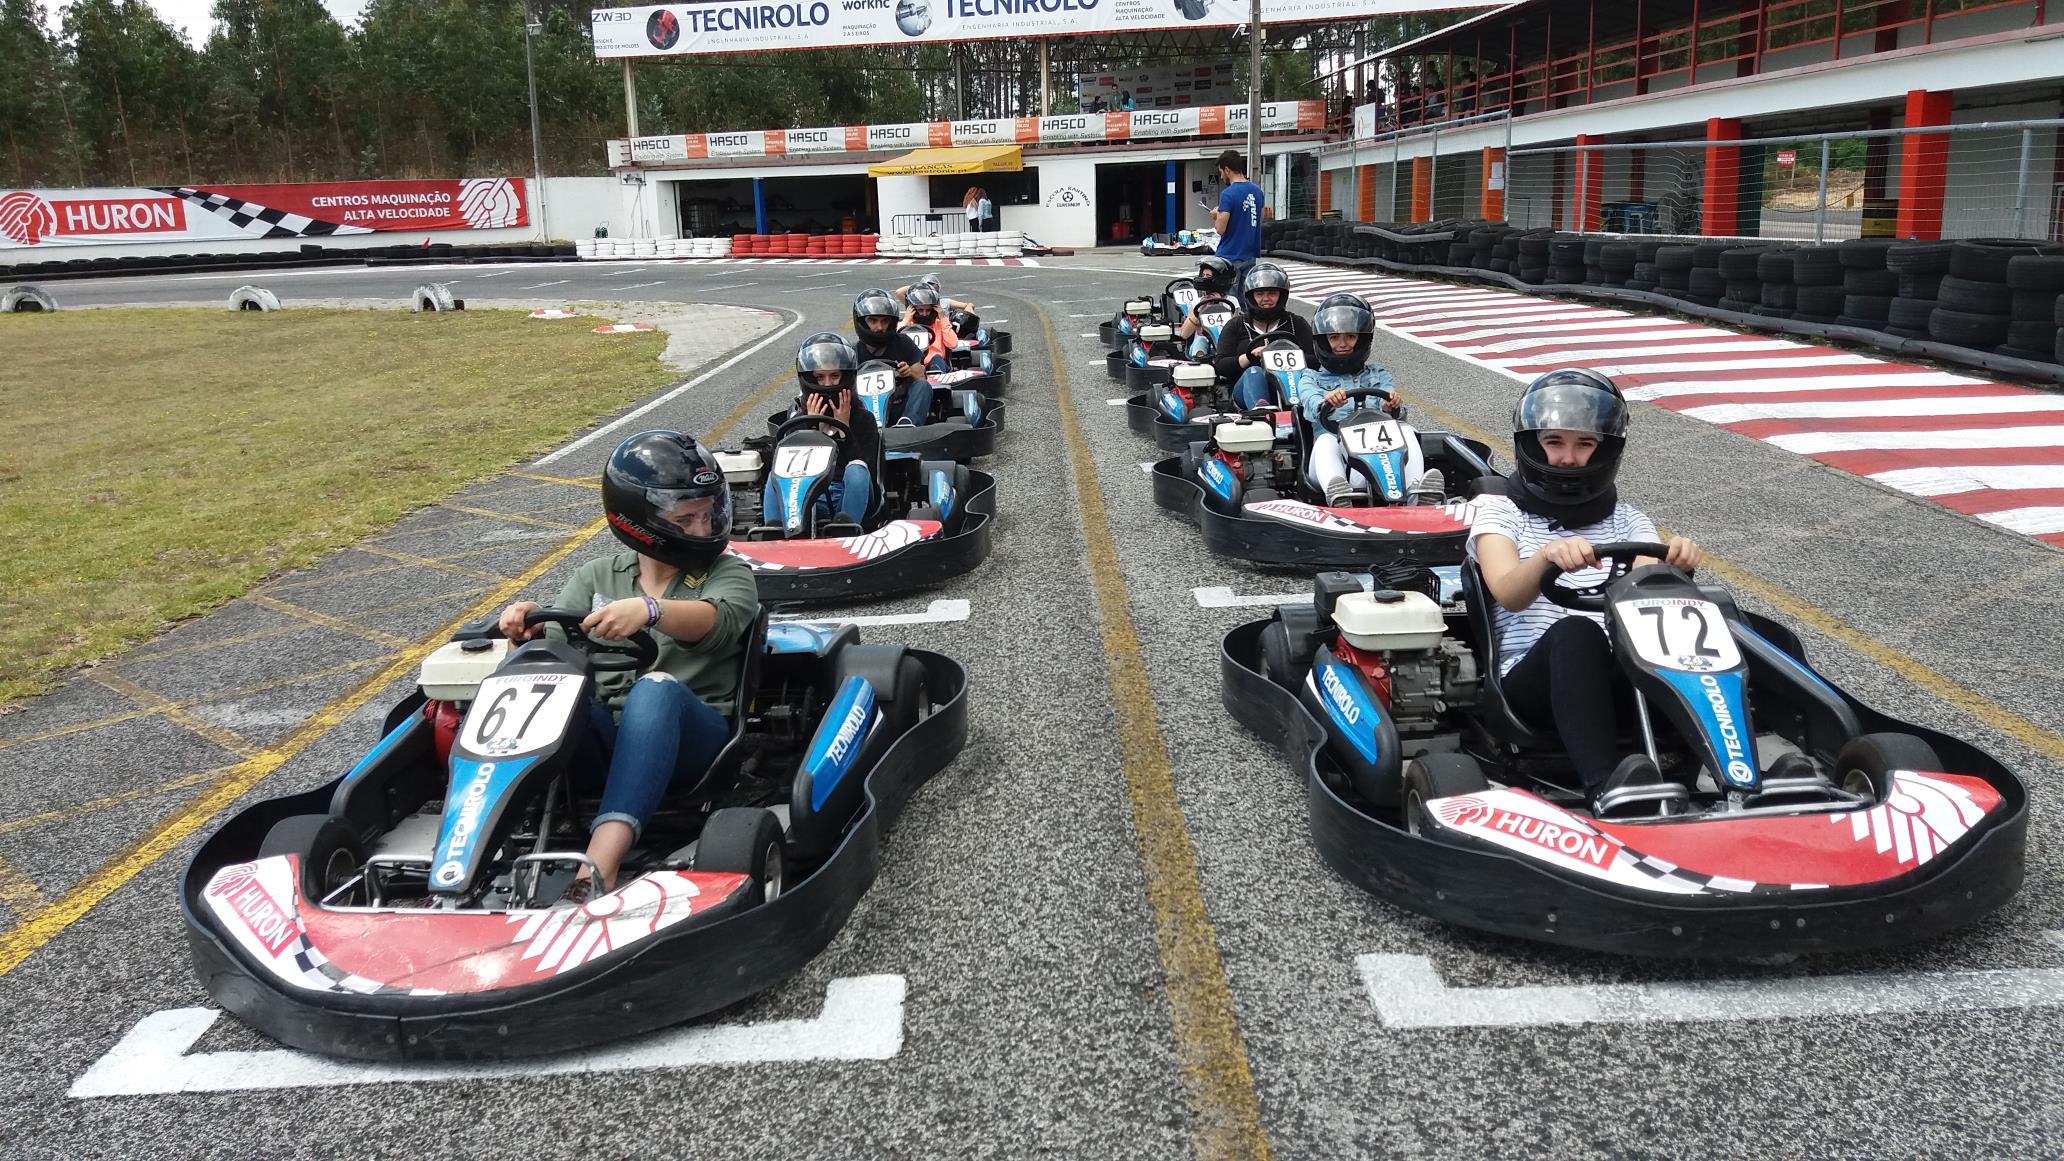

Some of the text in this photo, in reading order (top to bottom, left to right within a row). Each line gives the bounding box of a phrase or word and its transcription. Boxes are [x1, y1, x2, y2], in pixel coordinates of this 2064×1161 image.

[687, 2, 829, 32] TECNIROLO
[1116, 6, 1153, 14] MAQUINAÇÃO
[1249, 6, 1301, 14] EGENHARIA
[707, 36, 750, 45] ENGENHARIA
[1134, 113, 1179, 125] HASCO
[1229, 106, 1277, 120] HACO
[954, 123, 996, 135] HASCO
[1042, 118, 1085, 130] HASCO
[709, 135, 748, 147] HASCO
[789, 131, 828, 143] HASCO
[870, 127, 911, 139] HASCO
[633, 139, 670, 151] HASCO
[312, 191, 450, 207] CENTROS MAQUINAÇÃO
[65, 202, 176, 231] HURON
[344, 207, 450, 221] ALTA VELOCIDADE
[1178, 290, 1194, 303] 70
[1207, 314, 1224, 326] 64
[1273, 352, 1297, 368] 66
[863, 373, 886, 393] 75
[1353, 424, 1393, 449] 74
[786, 448, 814, 473] 71
[1379, 453, 1398, 491] TECNIROLO
[1273, 504, 1326, 522] HURON
[1632, 598, 1705, 607] EUROINDY
[1637, 605, 1721, 658] 72
[495, 674, 569, 685] EUROINDY
[1322, 664, 1361, 725] TECNIROLO
[476, 683, 557, 745] 67
[1700, 675, 1744, 759] TECNIROLO
[825, 705, 867, 767] TECNIROLO
[446, 762, 496, 860] TECNIROLO
[1496, 812, 1609, 865] HURON
[234, 885, 294, 951] HURON
